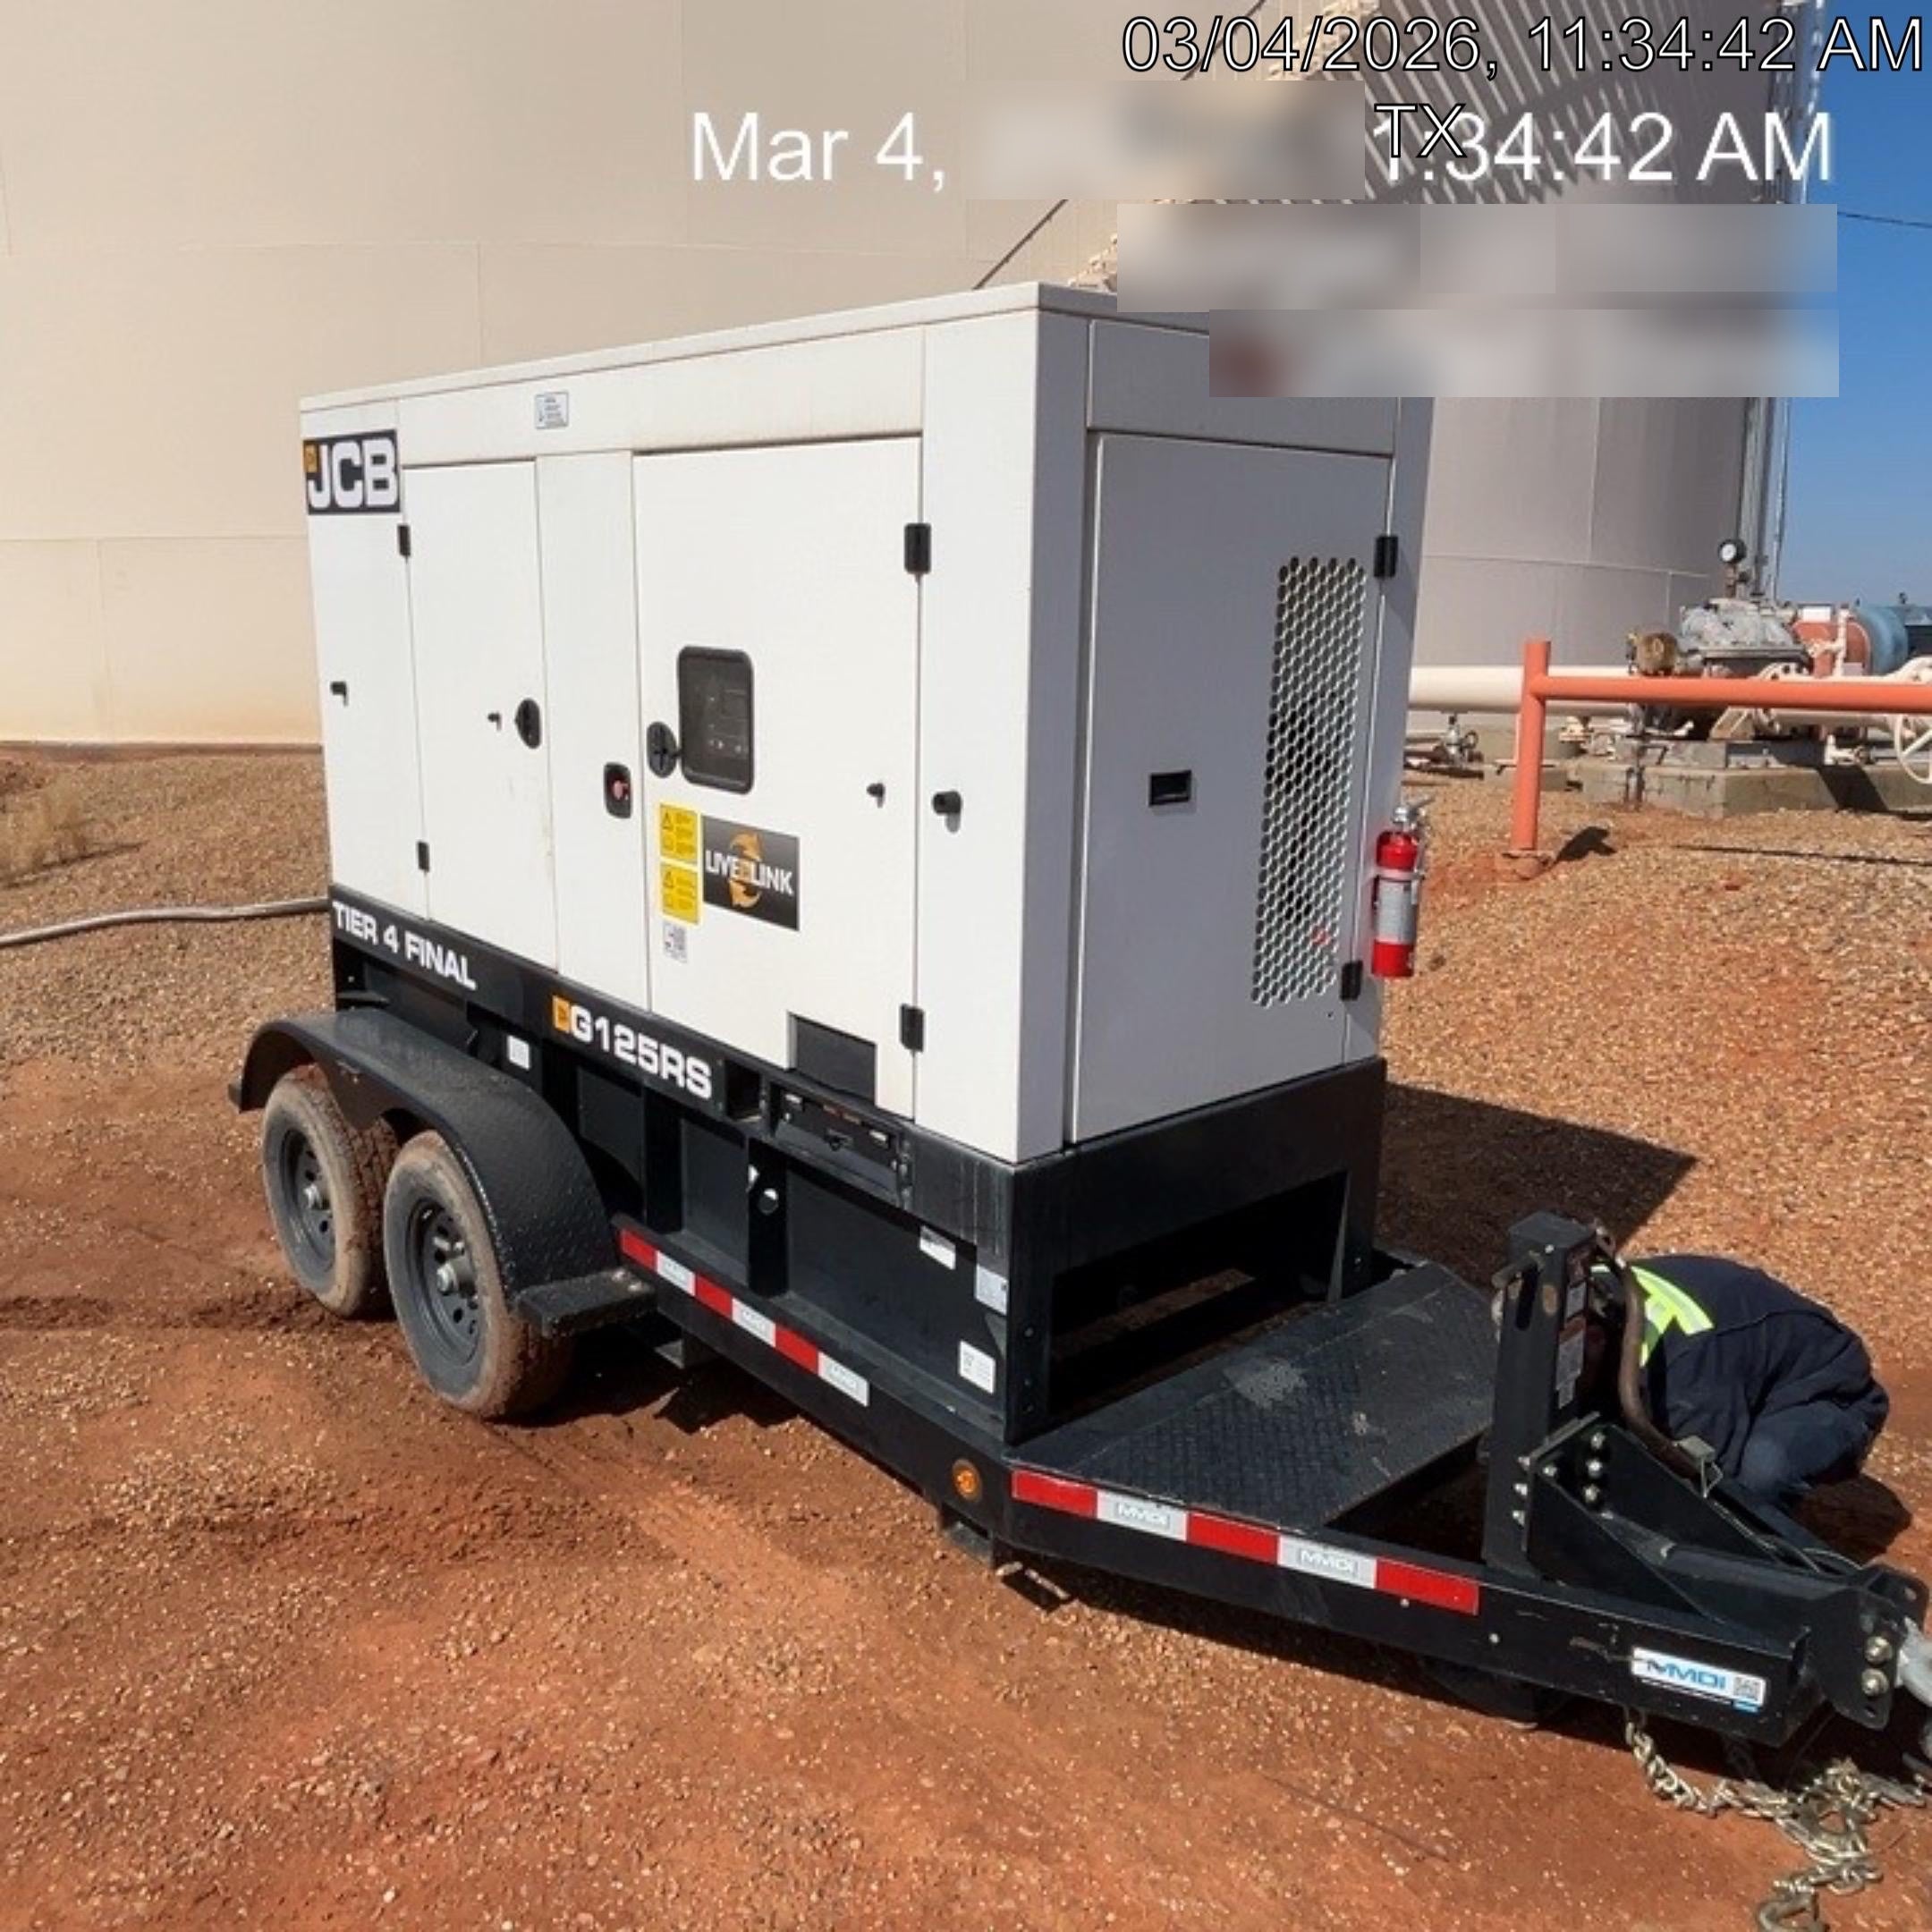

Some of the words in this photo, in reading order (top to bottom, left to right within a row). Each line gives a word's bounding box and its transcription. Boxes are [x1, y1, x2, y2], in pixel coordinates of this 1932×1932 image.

[307, 437, 399, 510] JCB
[332, 901, 378, 945] TIER
[383, 924, 400, 954] 4
[404, 932, 477, 991] FINAL
[570, 1004, 713, 1100] G125RS
